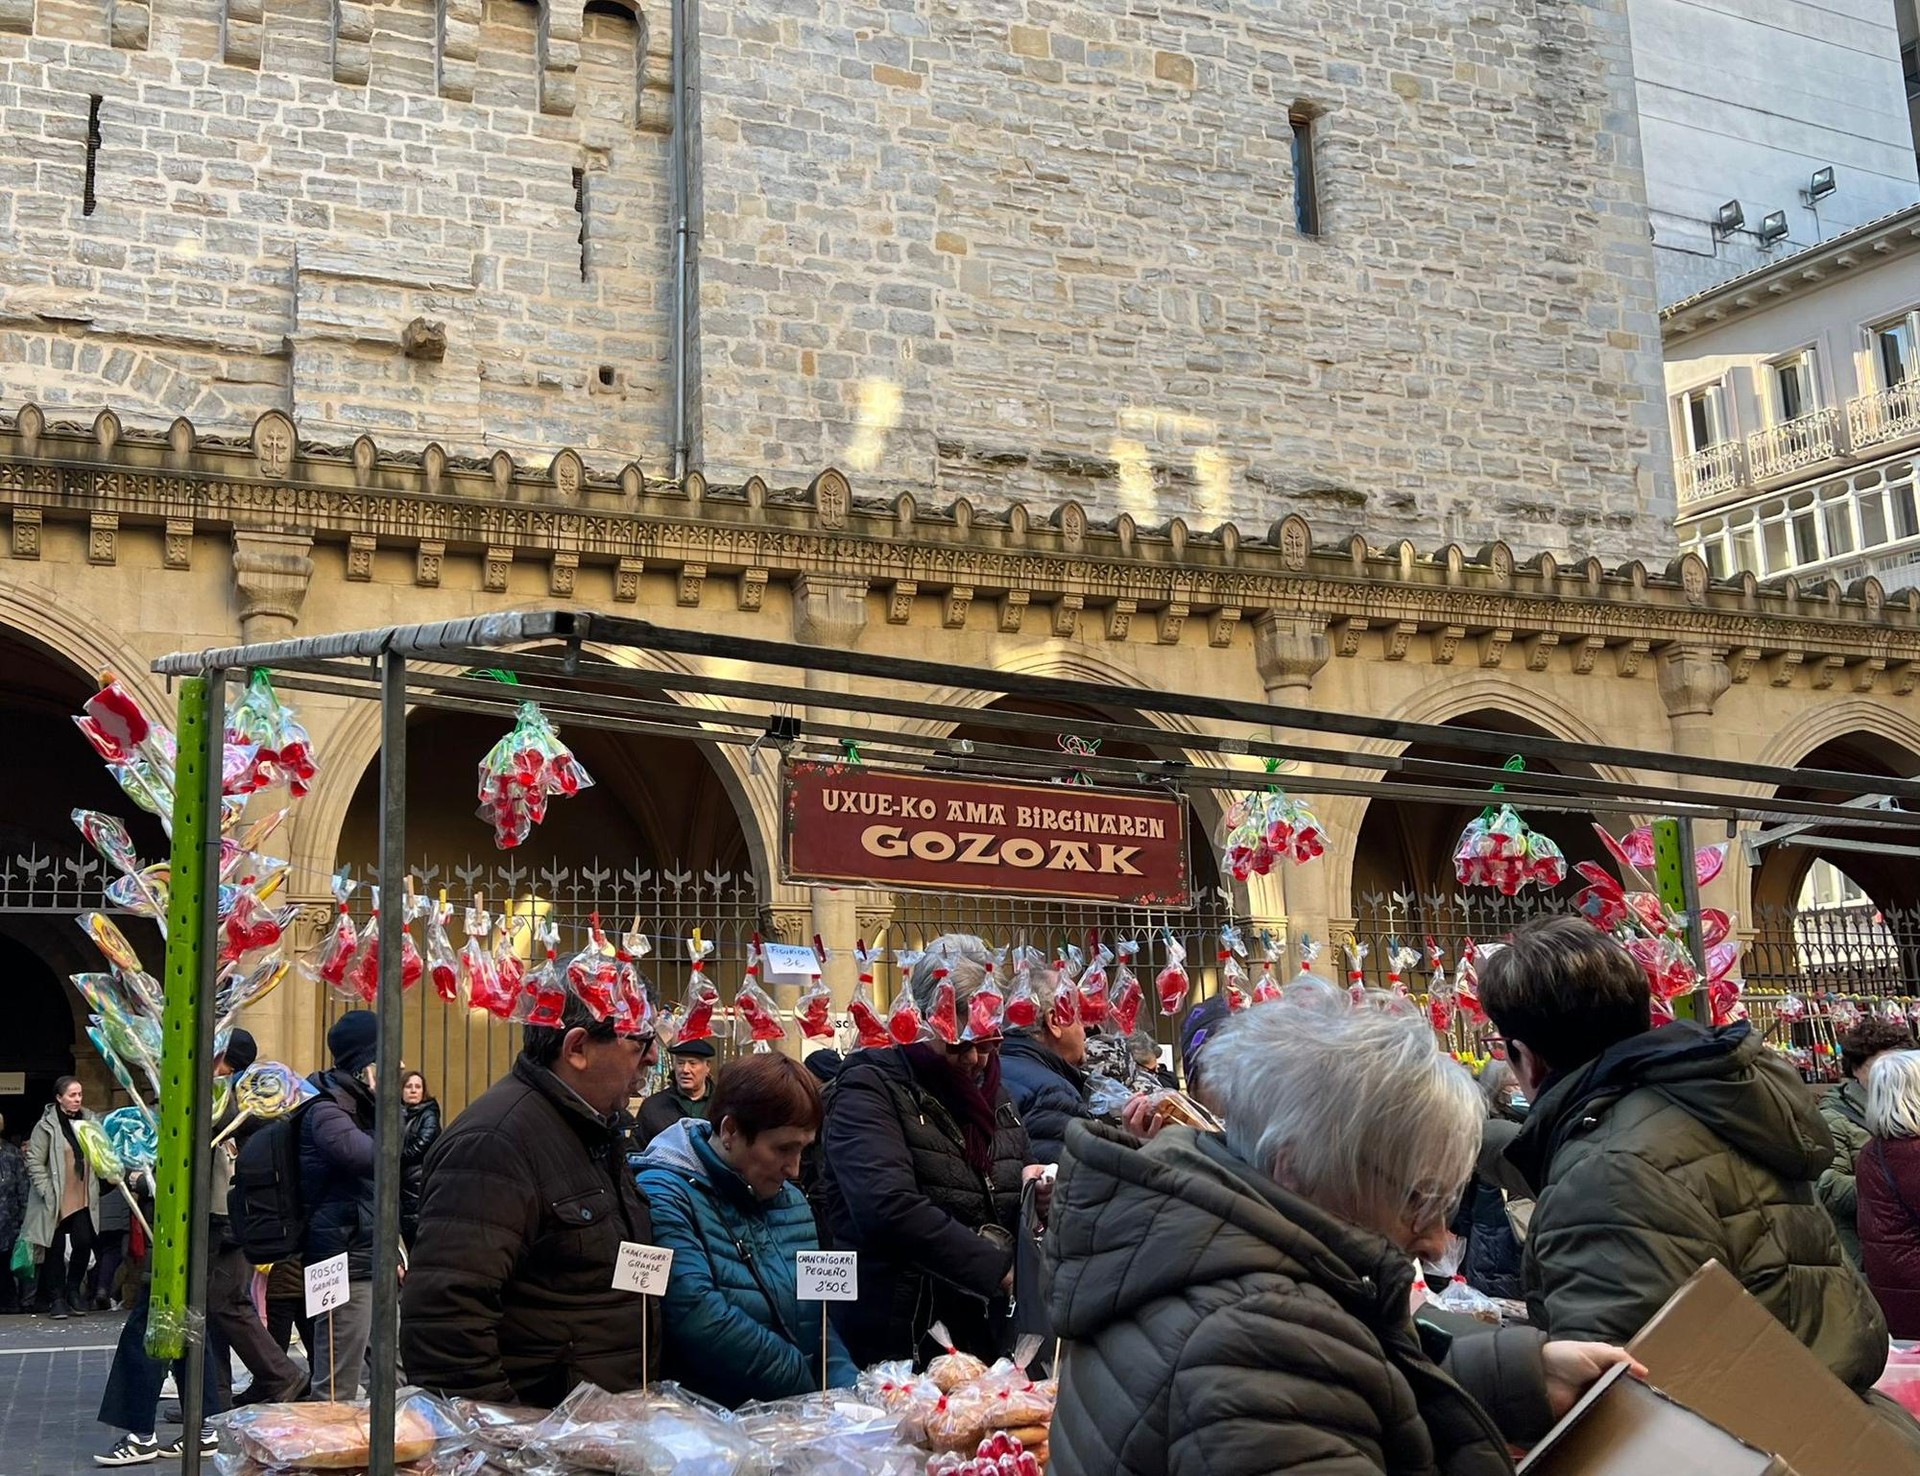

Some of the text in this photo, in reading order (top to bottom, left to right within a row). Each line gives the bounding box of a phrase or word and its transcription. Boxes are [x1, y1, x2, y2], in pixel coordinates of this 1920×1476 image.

[822, 788, 937, 820] UXUE-KO
[946, 799, 1006, 826] AMA
[861, 824, 1144, 876] GOZOAK
[310, 1261, 344, 1282] ROSCO
[627, 1260, 662, 1273] GRANDE
[805, 1265, 847, 1278] PEQUEÑO
[312, 1276, 340, 1293] GRANDE
[321, 1290, 336, 1307] 6€
